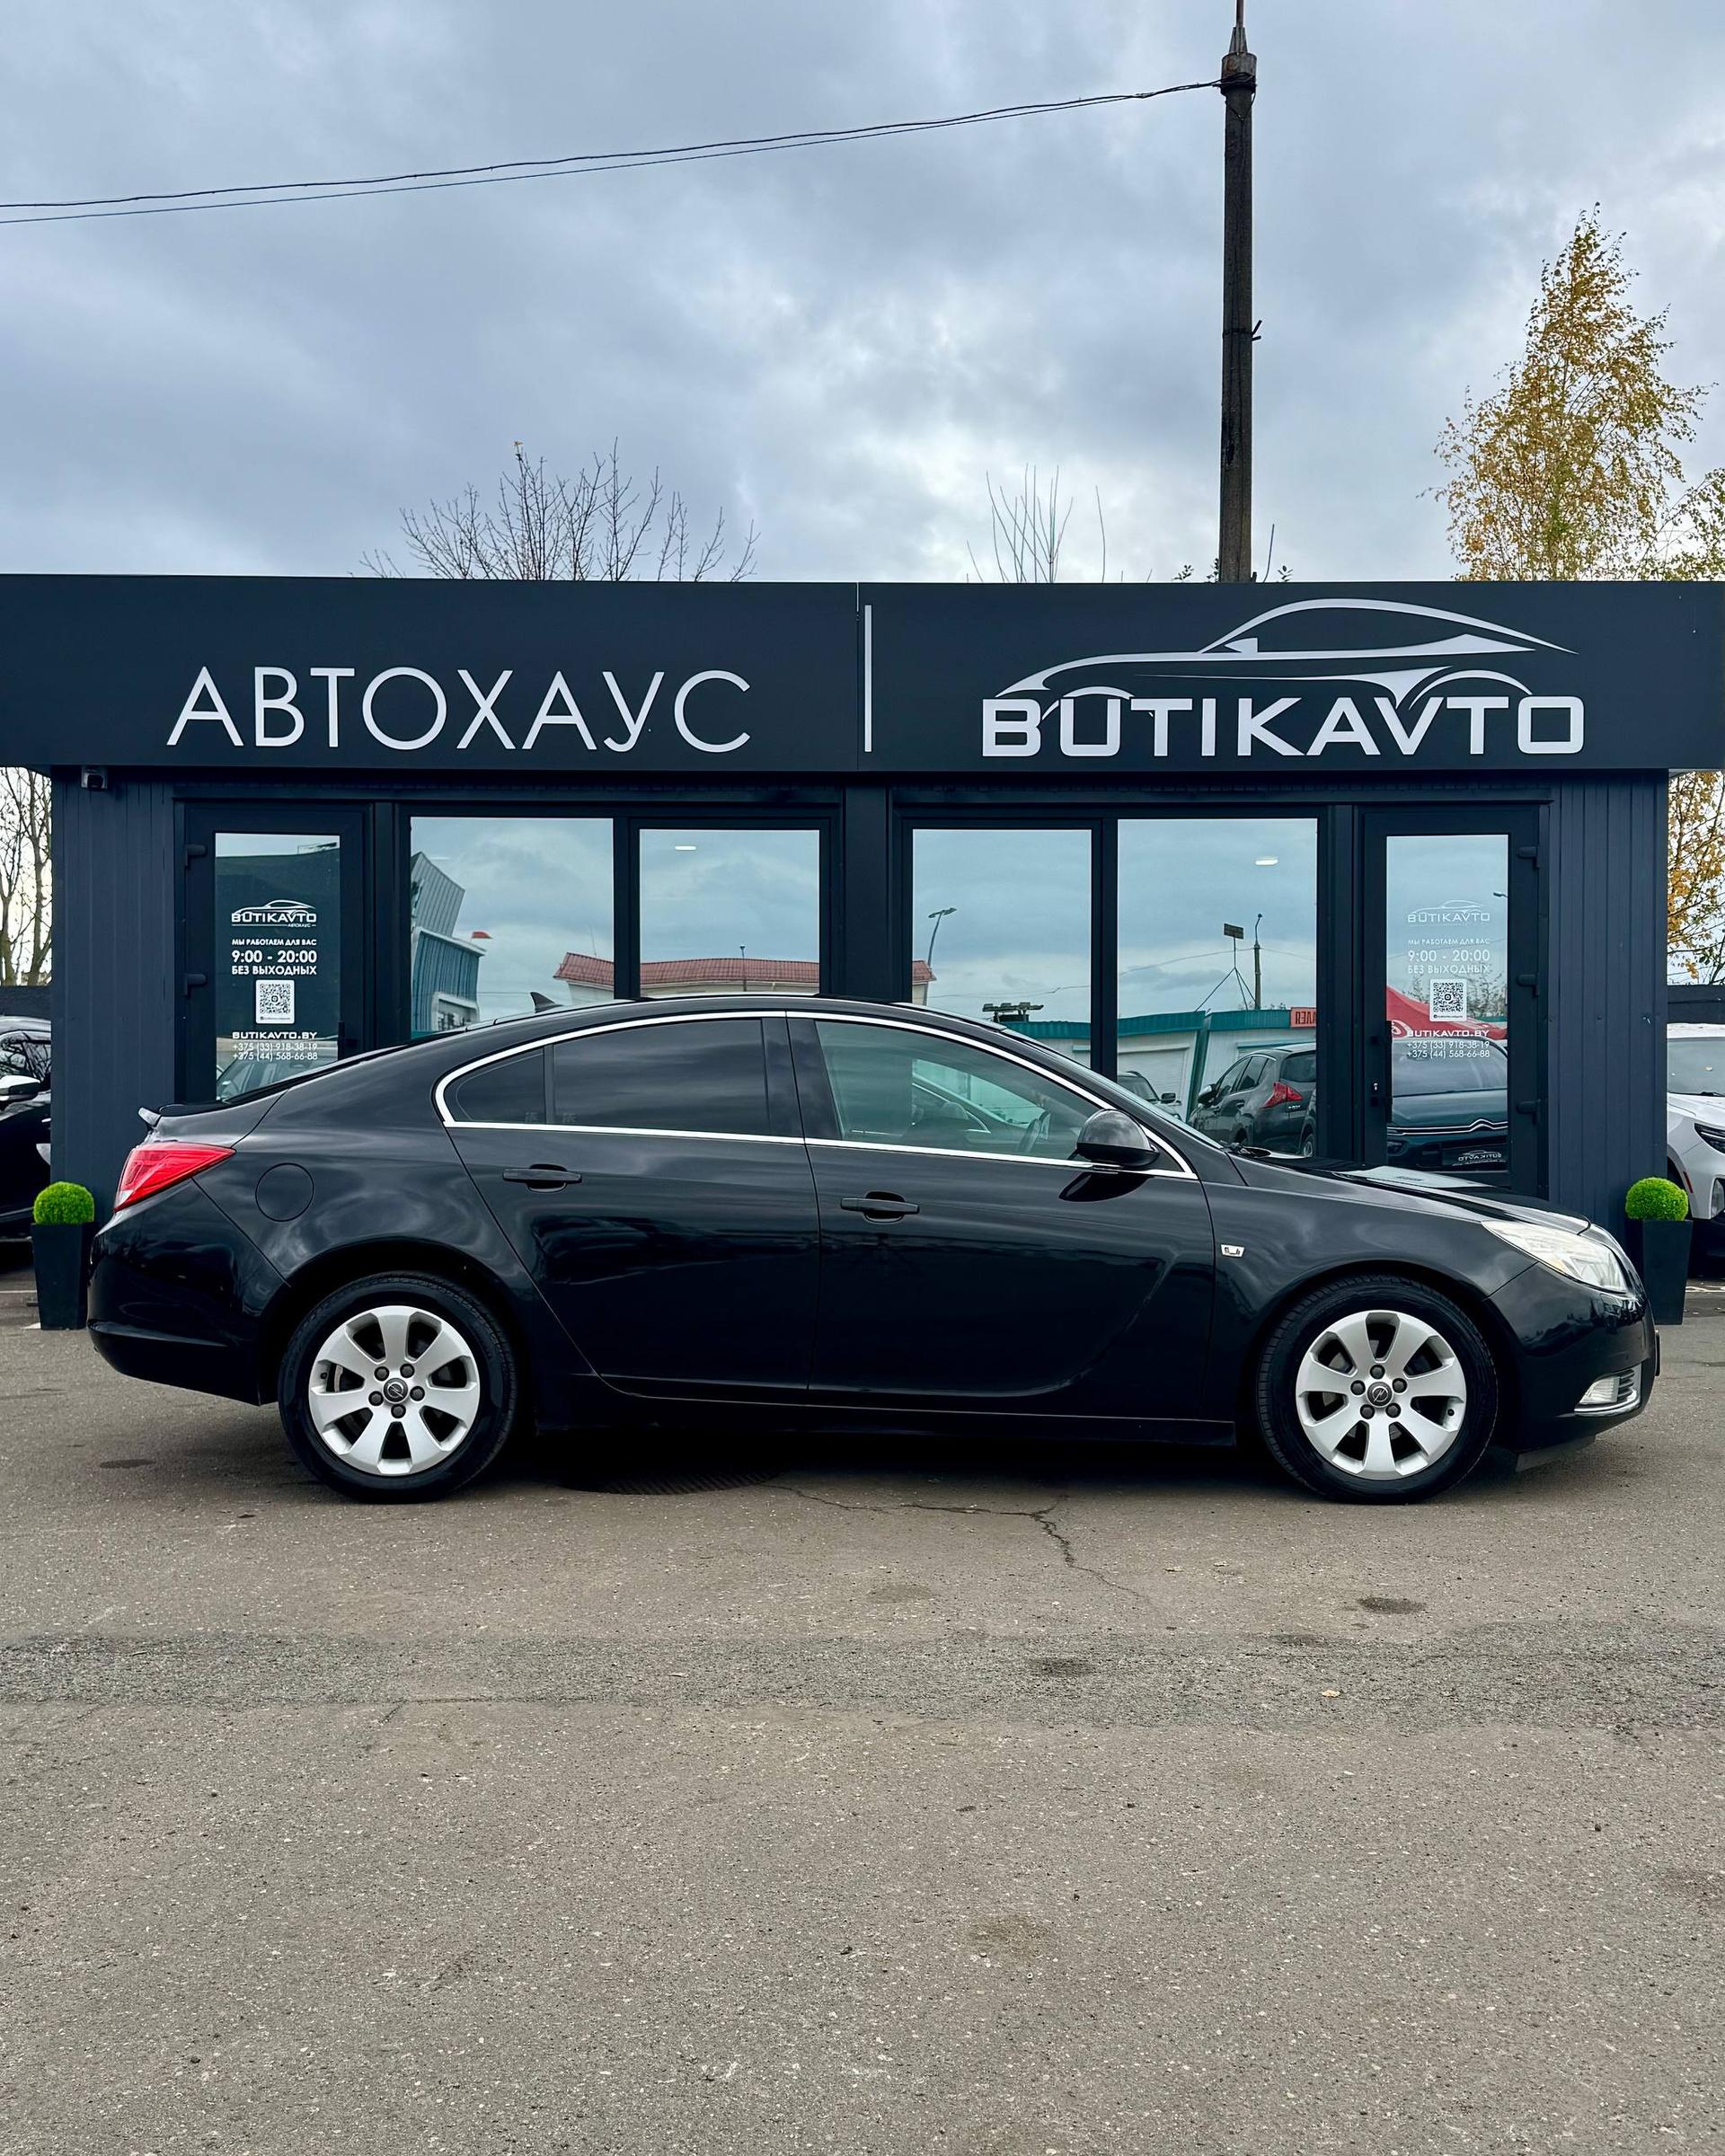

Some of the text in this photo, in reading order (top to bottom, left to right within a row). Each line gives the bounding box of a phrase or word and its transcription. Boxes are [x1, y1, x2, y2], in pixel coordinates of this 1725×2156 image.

[166, 666, 751, 753] АВТОХАУС
[982, 695, 1585, 757] BUTIKAVTO
[231, 911, 317, 923] BUTIKAVTO
[1408, 912, 1491, 923] BUTIKAVTO
[232, 950, 263, 963] 9:00
[277, 950, 317, 963] 20:00
[1408, 950, 1437, 962] 9:00
[1452, 949, 1491, 962] 20:00
[232, 966, 317, 976] БЕЗ ВЫХОДНЫХ
[1408, 964, 1491, 975] БЕЗ ВЫХОДНЫХ
[232, 1031, 318, 1039] BUTIKAVTO.BY
[233, 1042, 254, 1051] +375
[257, 1042, 273, 1052] (33)
[1407, 1040, 1491, 1050] +375 (33) 918-38-19
[233, 1051, 318, 1062] +375 (44) 568-66-88
[1407, 1049, 1491, 1059] +375 (44) 568-66-88
